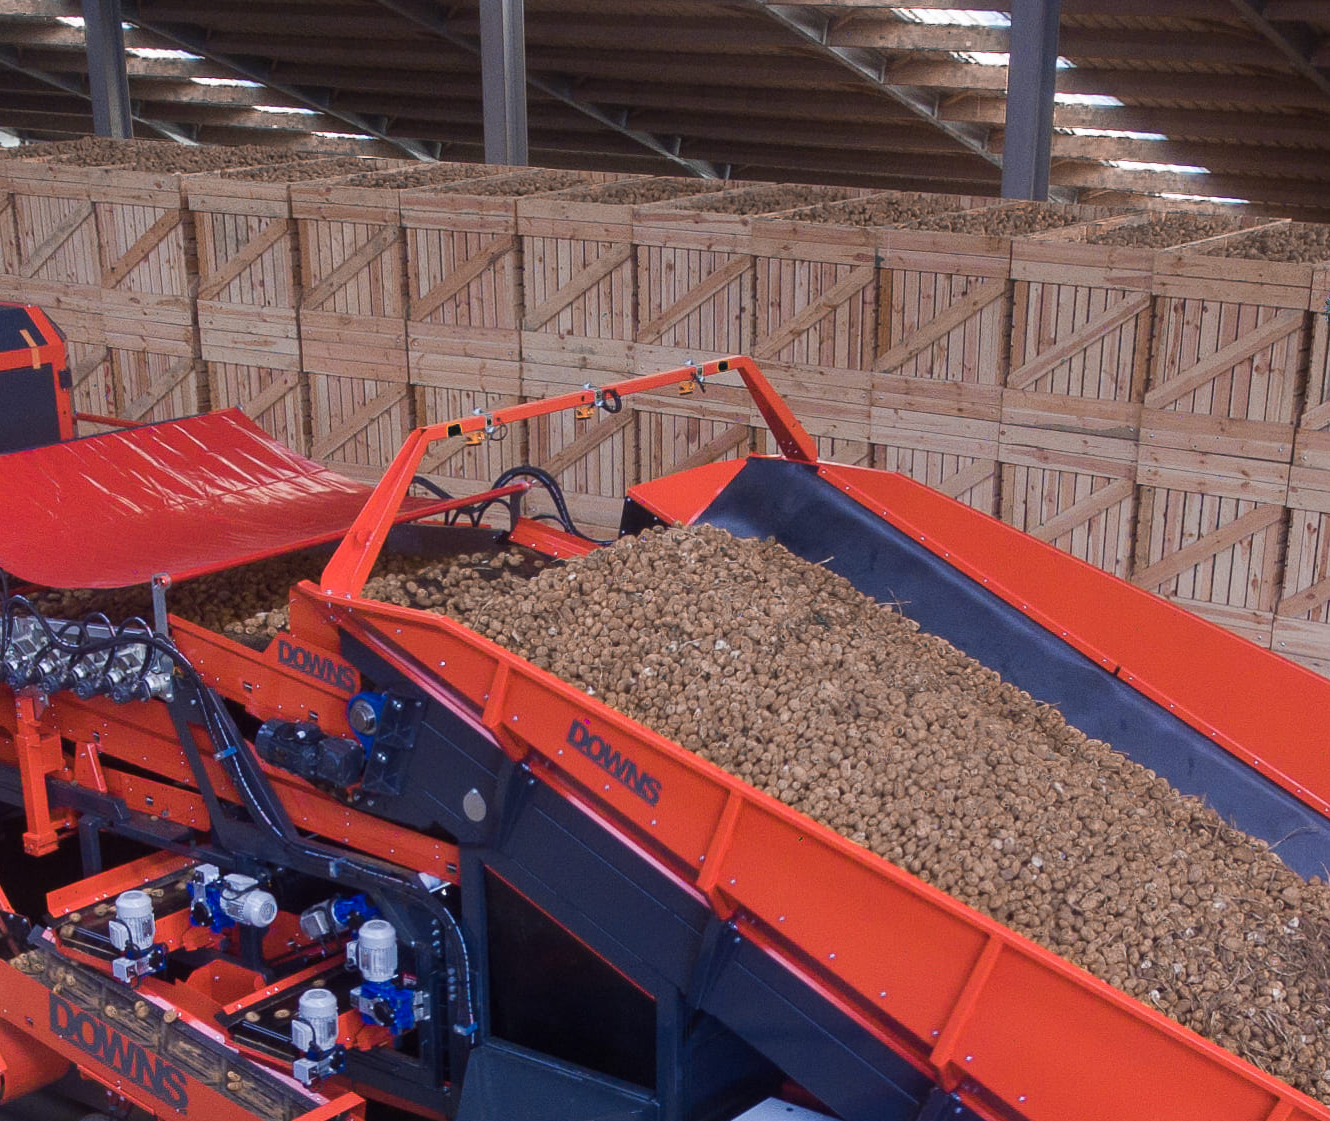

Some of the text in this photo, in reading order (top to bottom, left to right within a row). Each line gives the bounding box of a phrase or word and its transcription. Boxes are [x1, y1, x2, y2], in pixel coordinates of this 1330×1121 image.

[277, 639, 356, 694] DOWNS
[566, 719, 662, 807] DOWNS
[48, 991, 189, 1113] DOWNS
